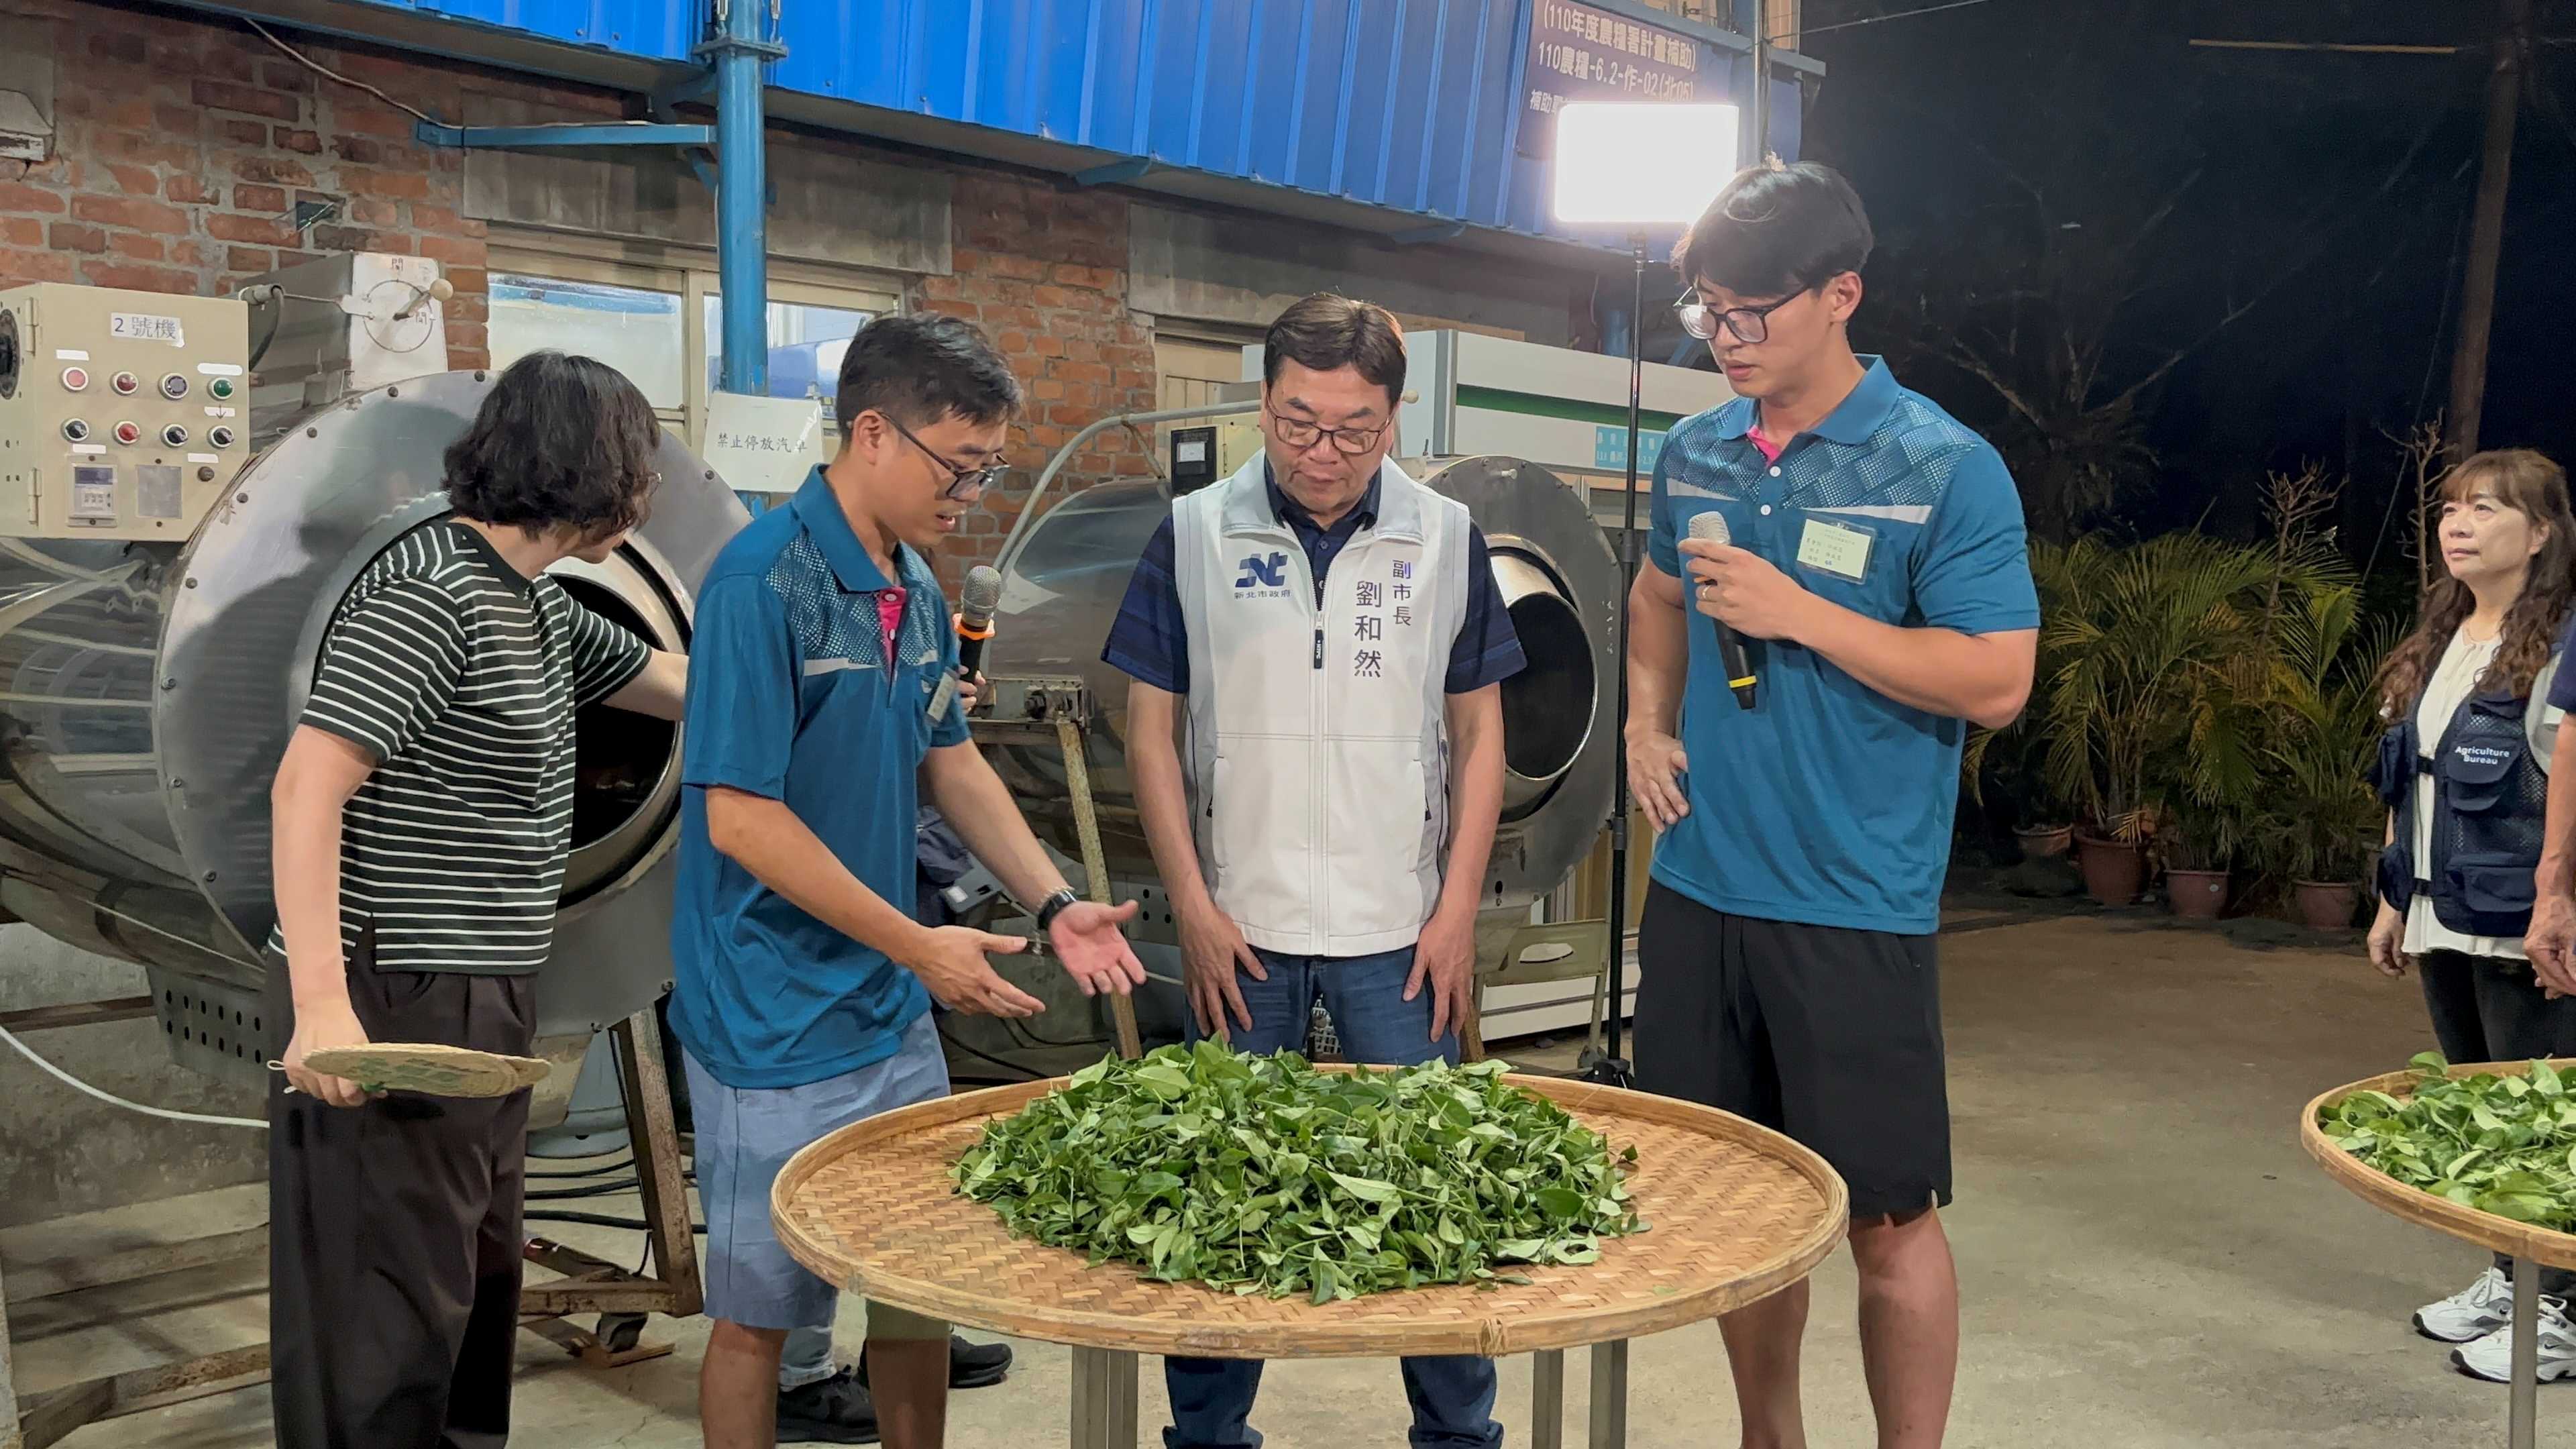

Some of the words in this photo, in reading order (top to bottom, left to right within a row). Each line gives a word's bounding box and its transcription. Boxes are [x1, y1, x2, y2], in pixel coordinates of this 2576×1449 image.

[115, 318, 124, 332] 2
[1234, 590, 1291, 600] 新北市政府
[1393, 559, 1411, 626] 副市長
[1354, 580, 1382, 678] 劉和然
[2455, 746, 2510, 757] Agriculture
[2463, 755, 2498, 765] Bureau
